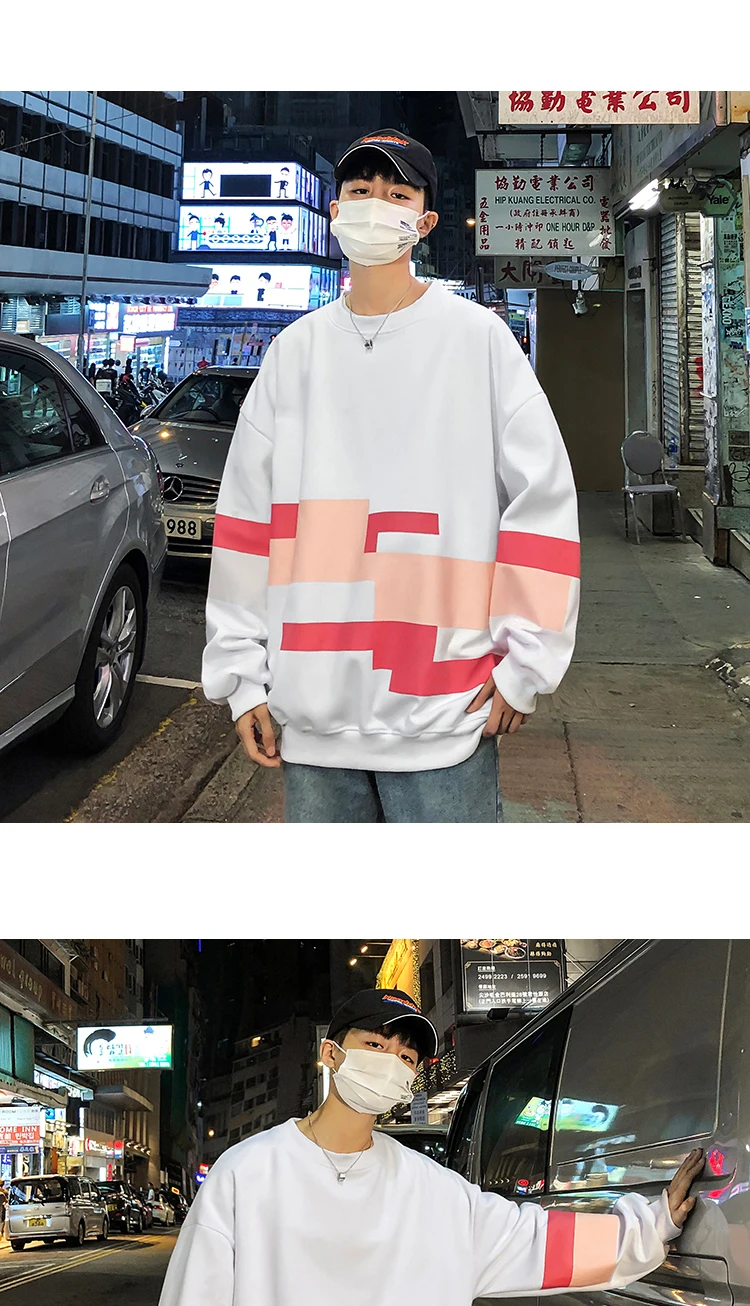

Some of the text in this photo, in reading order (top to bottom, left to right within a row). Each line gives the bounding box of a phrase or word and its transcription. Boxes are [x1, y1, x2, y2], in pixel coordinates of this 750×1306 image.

[508, 91, 691, 113] 協勤電業公司
[495, 175, 594, 191] 協勤電業公司
[495, 196, 596, 204] HIP KUANG ELECTRICAL CO.
[706, 195, 729, 204] Yale
[479, 197, 490, 250] 五金用品
[546, 222, 559, 231] ONE
[561, 222, 580, 231] HOUR
[582, 222, 596, 231] D&P
[600, 196, 612, 251] 電器批發
[515, 238, 575, 250] 精配鎖匙
[499, 259, 564, 284] 大閘
[167, 519, 196, 535] 988
